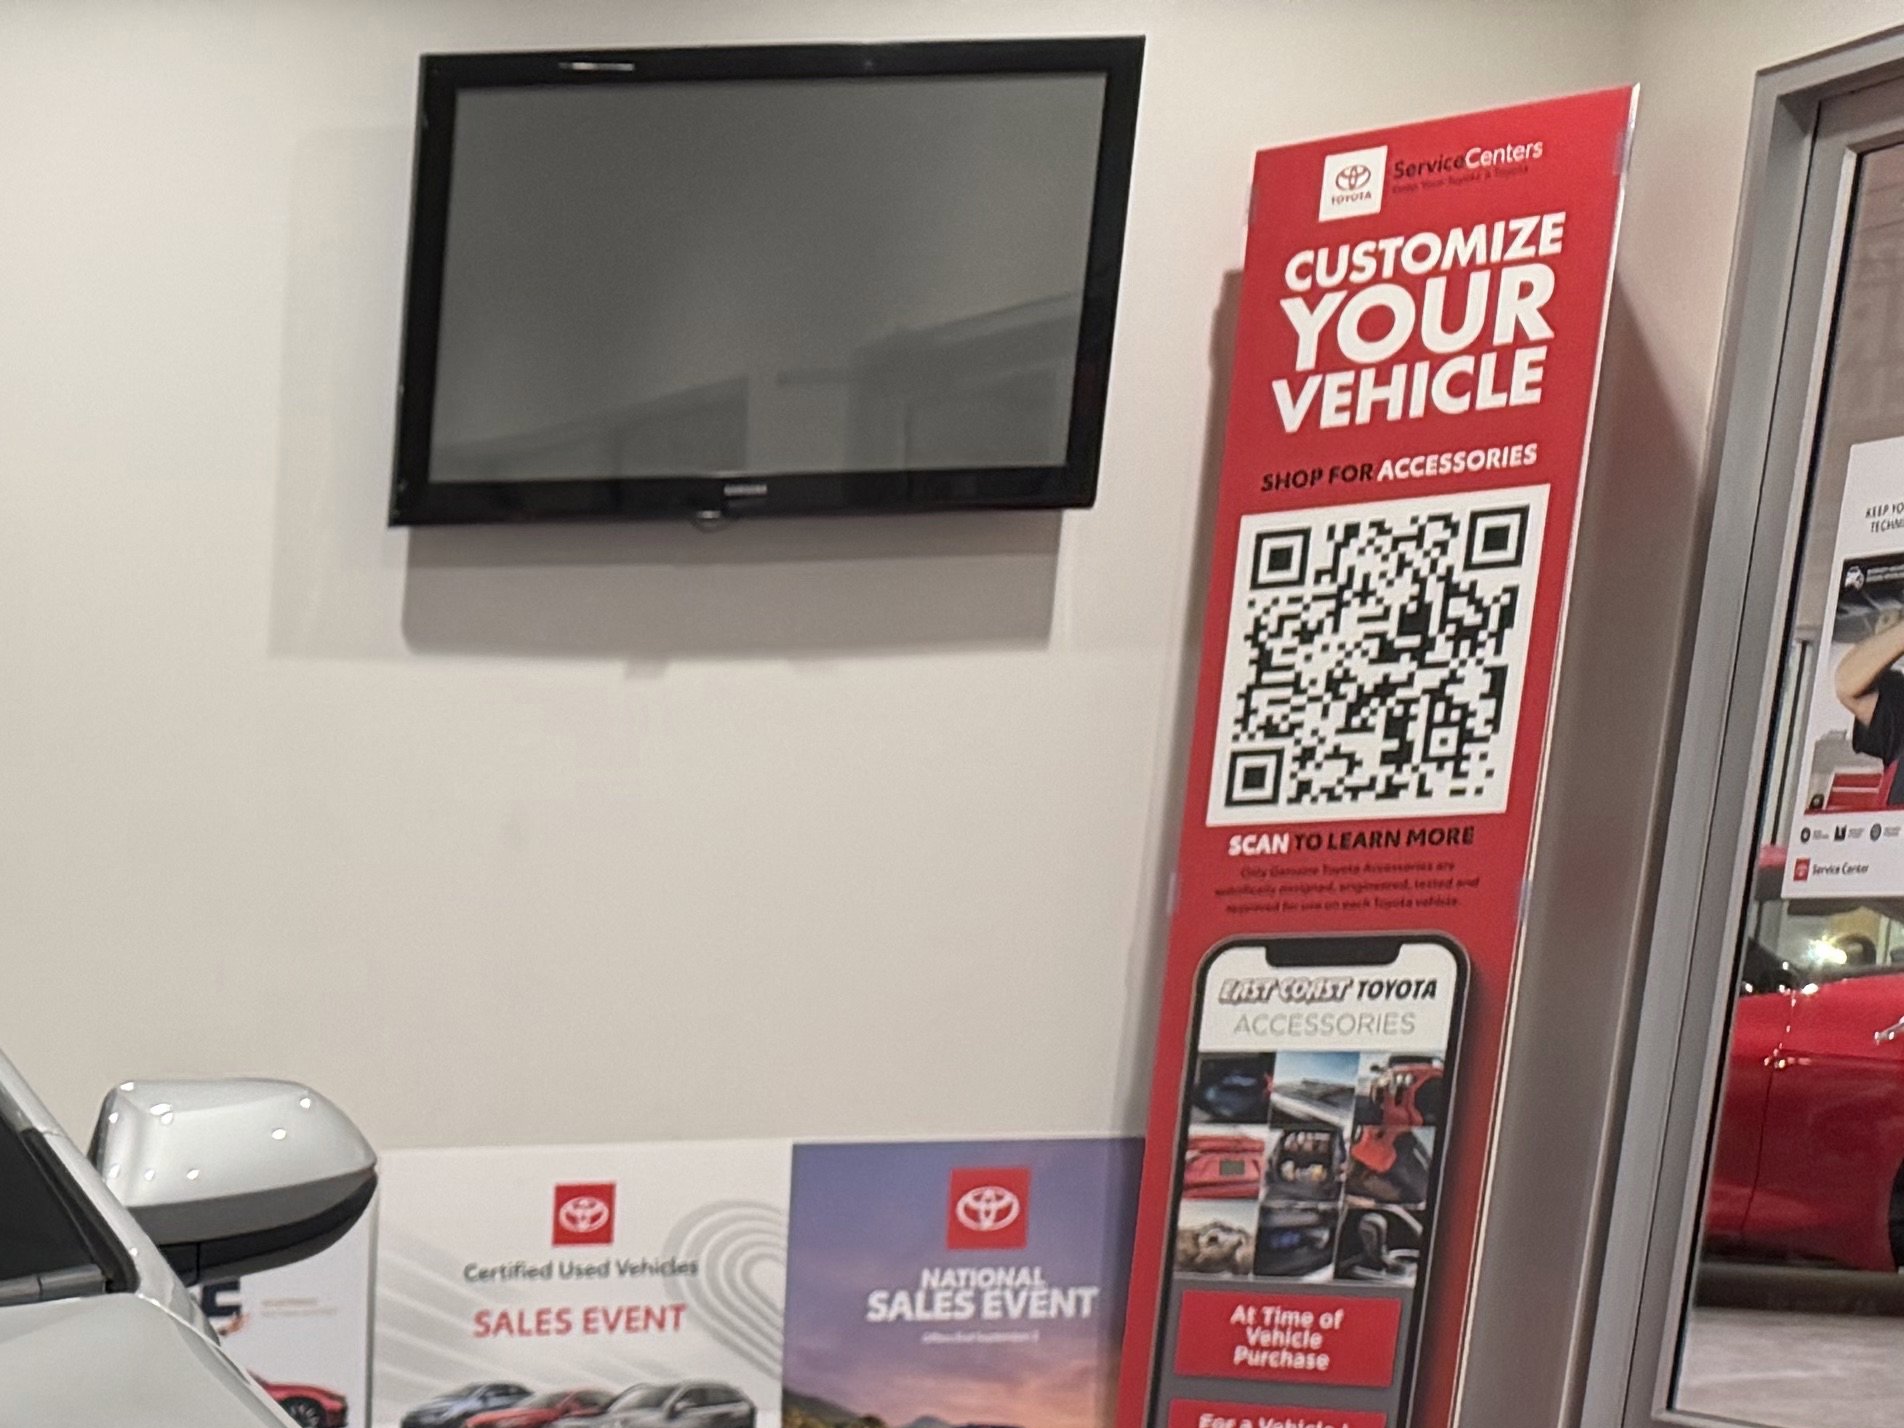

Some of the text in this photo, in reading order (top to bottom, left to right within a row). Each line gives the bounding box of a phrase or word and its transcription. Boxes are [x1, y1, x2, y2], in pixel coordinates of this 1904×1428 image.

[1331, 191, 1373, 206] TOYOTA
[1284, 211, 1566, 292] CUSTOMIZE
[1279, 263, 1555, 372] YOUR
[1272, 345, 1548, 434] VEHICLE
[1261, 443, 1538, 492] SHOP FOR ACCESSORIES
[1228, 826, 1475, 856] SCAN TO LEARN MORE
[1218, 975, 1438, 1006] EAST COAST TOYOTA
[1233, 1011, 1416, 1037] ACCESSORIES
[463, 1257, 699, 1283] Certified Used Vehicles
[920, 1265, 1048, 1290] NATIONAL
[865, 1286, 1100, 1323] SALES EVENT
[1230, 1304, 1345, 1330] At Time of
[473, 1302, 688, 1338] SALES EVENT
[1245, 1326, 1324, 1350] Vehicle
[1233, 1345, 1331, 1371] Purchase
